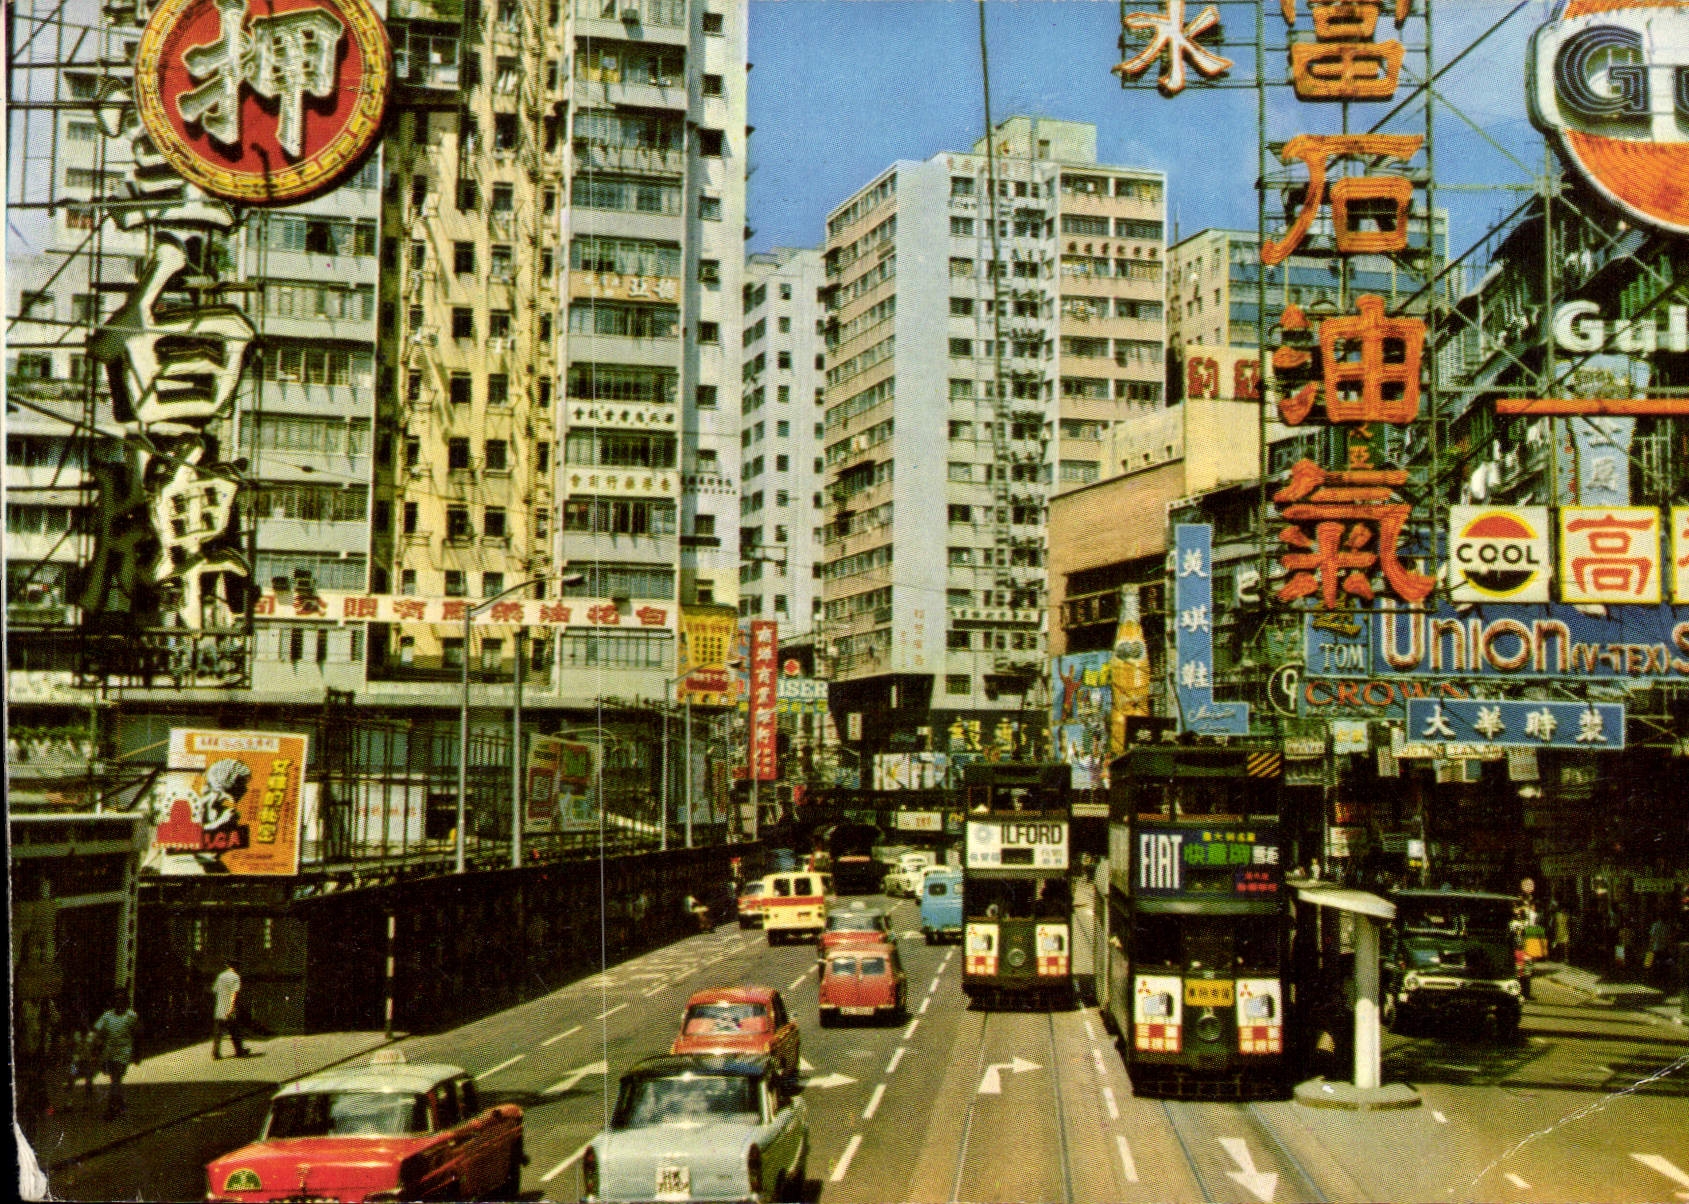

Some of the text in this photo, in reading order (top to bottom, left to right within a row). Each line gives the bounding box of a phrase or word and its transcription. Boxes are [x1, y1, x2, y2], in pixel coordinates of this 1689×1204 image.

[176, 0, 346, 159] 押
[1555, 25, 1689, 114] G
[1457, 543, 1540, 565] COOL
[1001, 823, 1063, 845] ILFORD
[1140, 833, 1182, 889] FIAT
